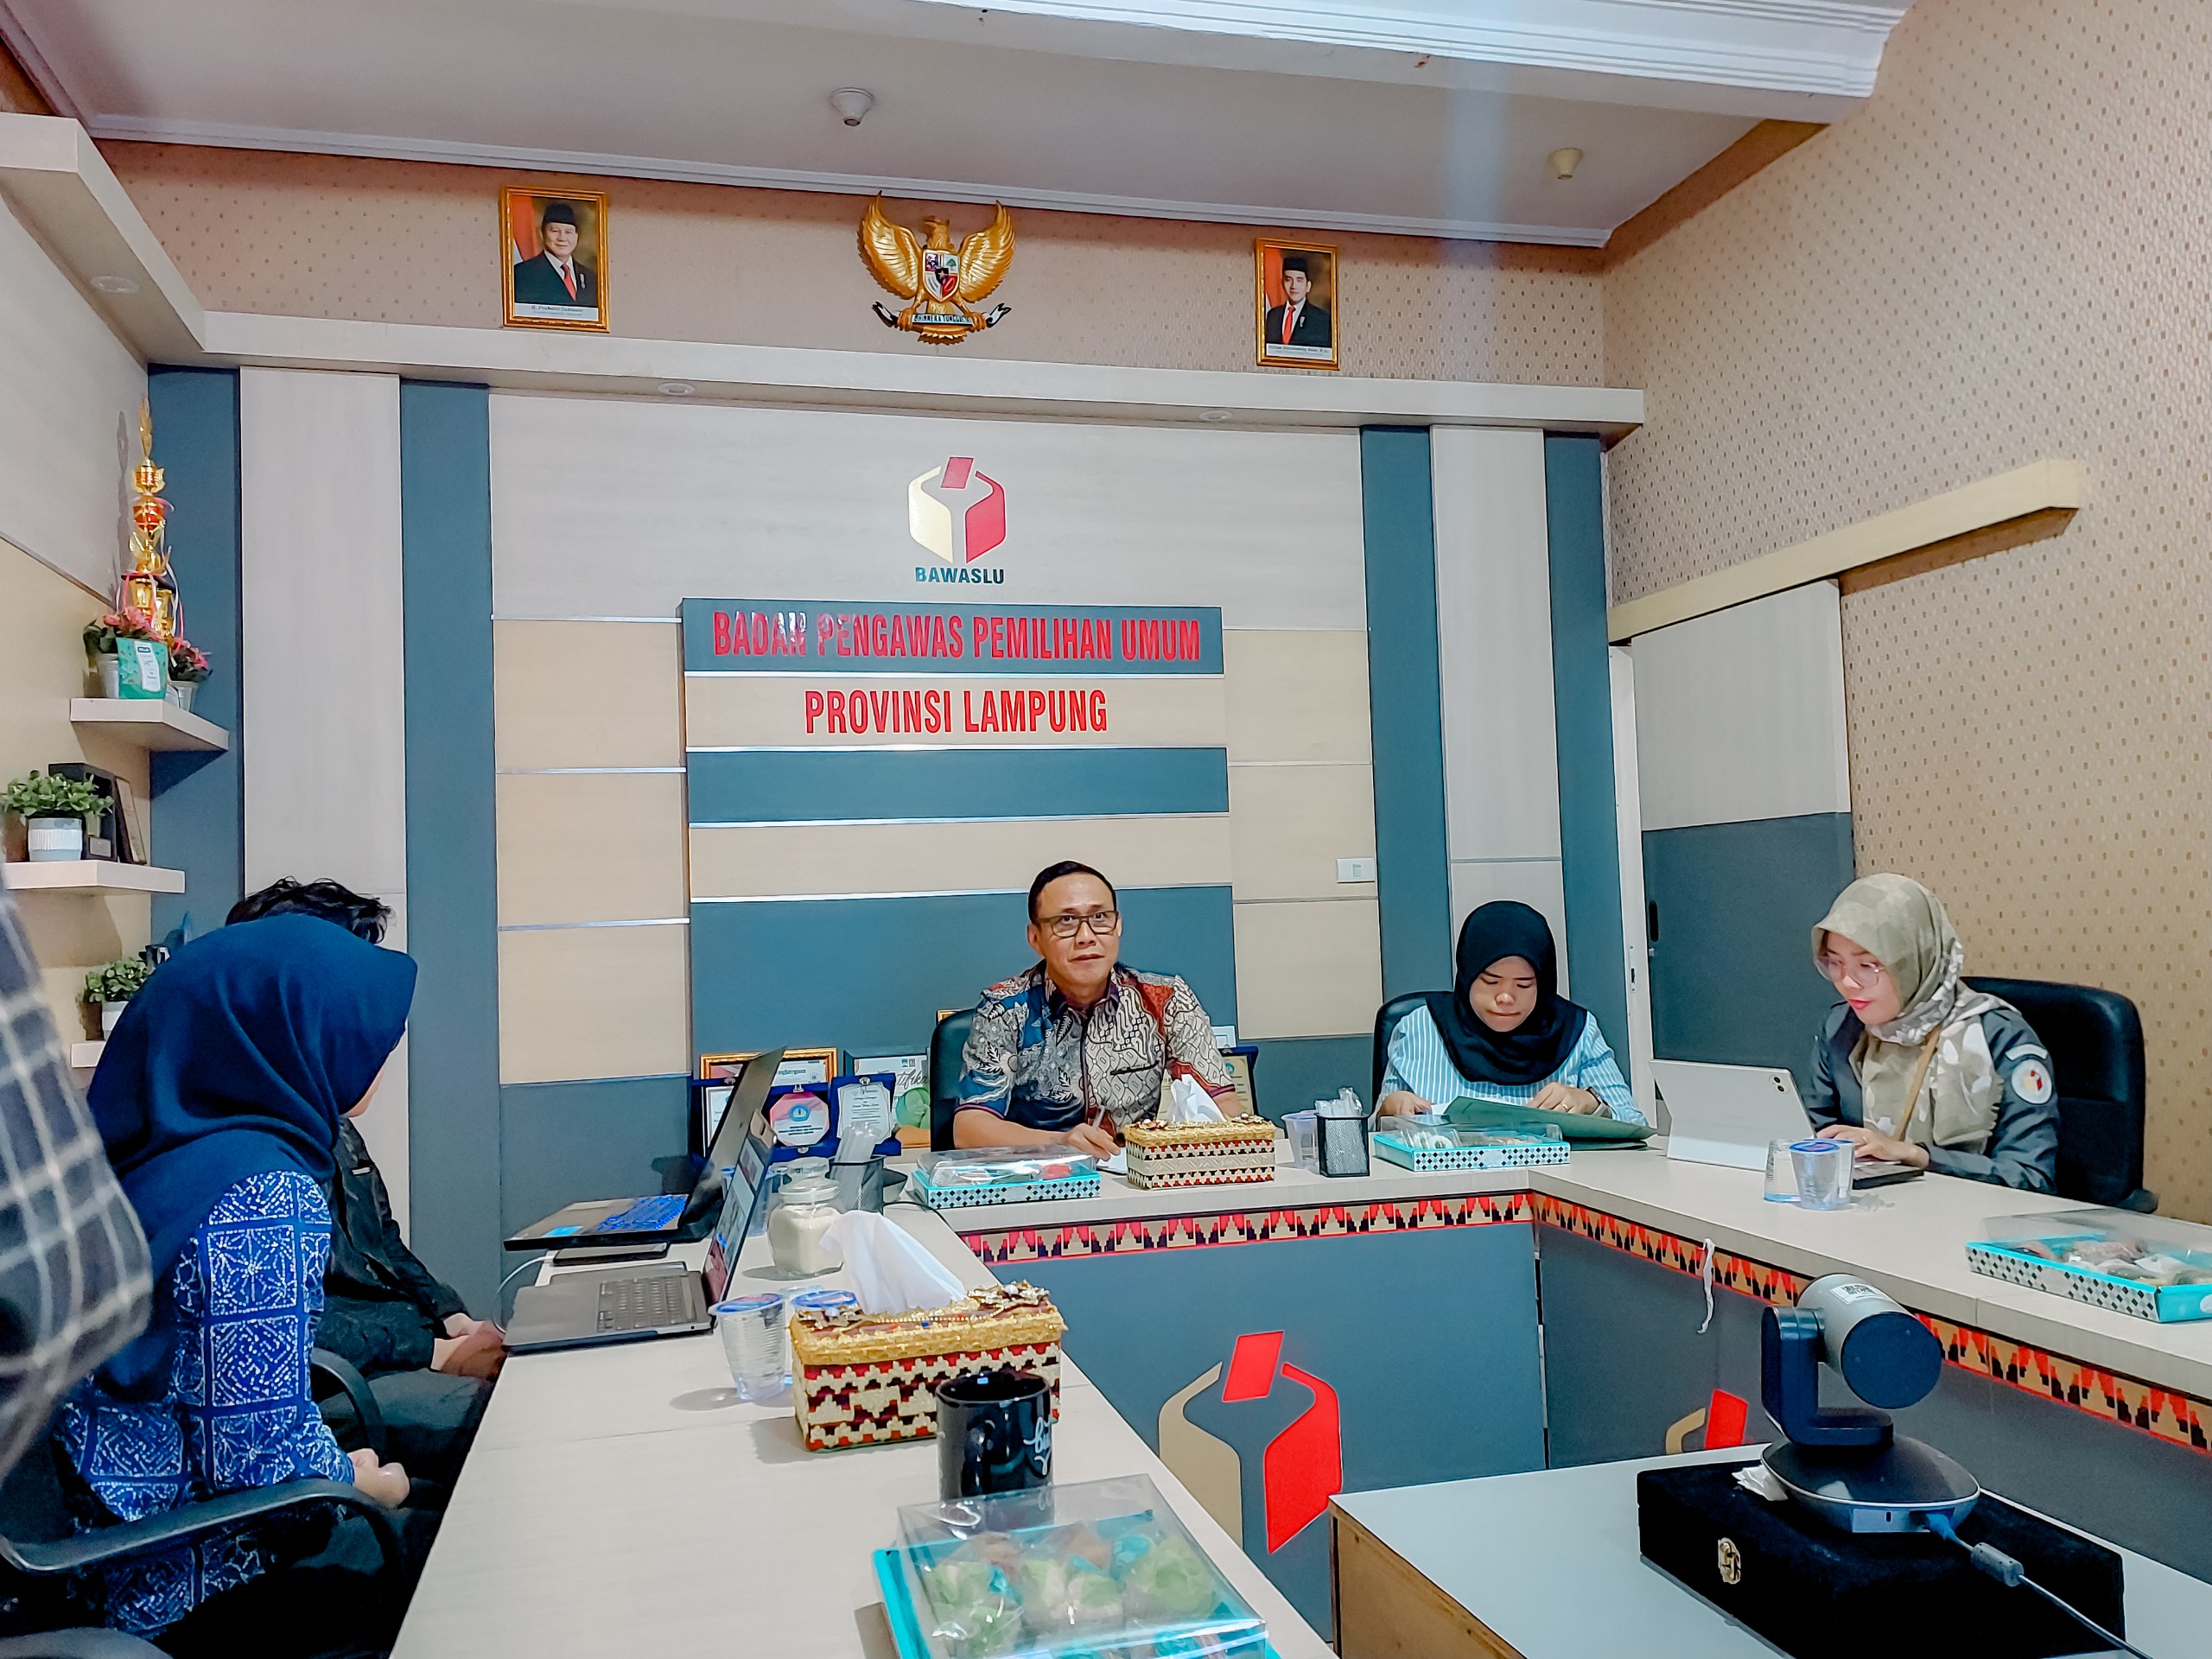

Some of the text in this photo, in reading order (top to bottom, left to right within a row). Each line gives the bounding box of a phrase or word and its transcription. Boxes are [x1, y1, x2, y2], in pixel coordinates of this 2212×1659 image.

[915, 567, 1005, 584] BAWASLU
[713, 611, 1200, 661] BADAN PENGAWAS PEMILIHAN UMUM
[804, 689, 1107, 734] PROVINSI LAMPUNG
